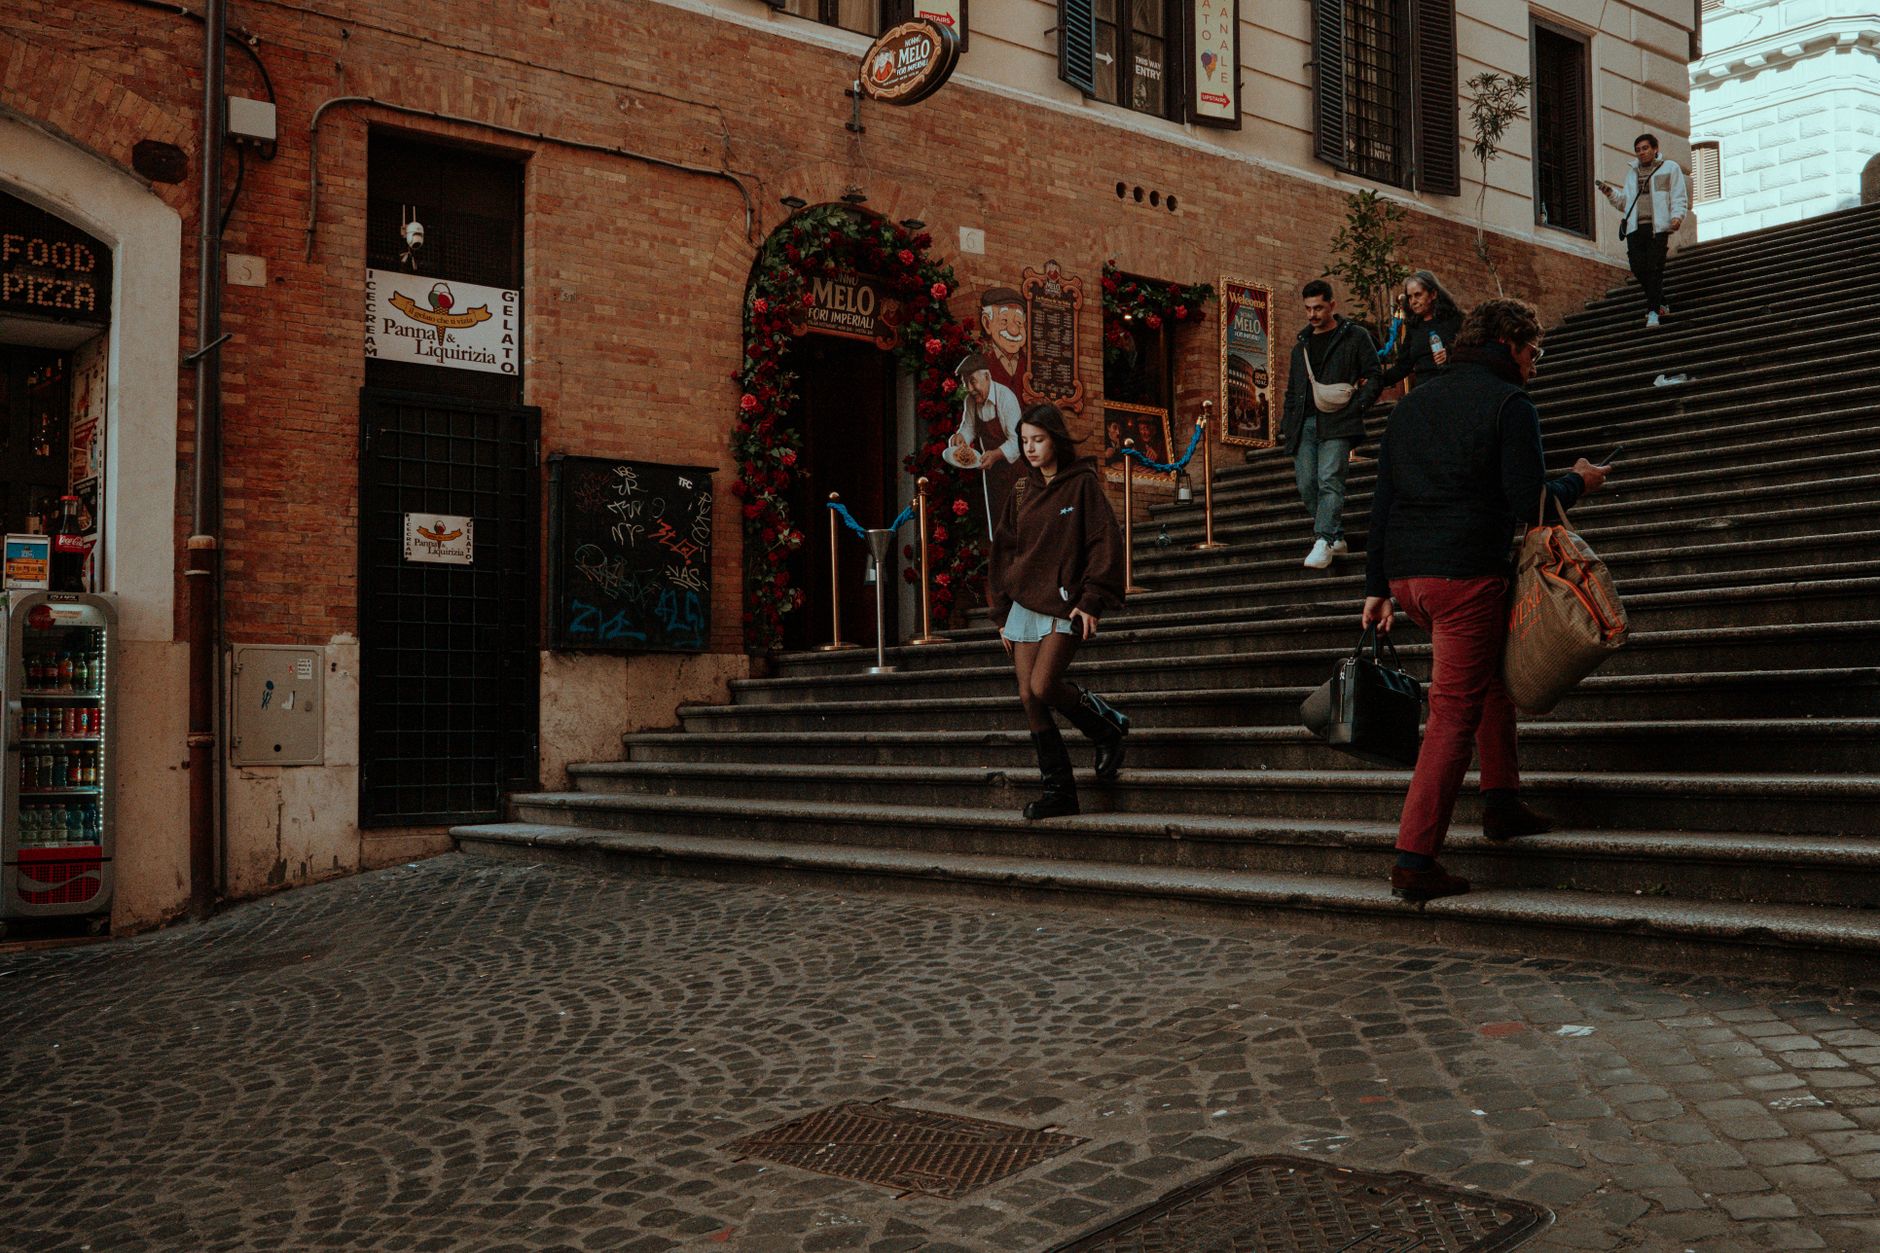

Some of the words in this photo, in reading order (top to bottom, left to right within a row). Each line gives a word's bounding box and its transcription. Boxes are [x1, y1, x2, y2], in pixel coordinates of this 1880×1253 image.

[920, 13, 951, 24] UPSTAIRS
[1219, 0, 1229, 84] ANALE
[897, 39, 931, 69] MELO
[1135, 56, 1148, 66] THIS
[1149, 59, 1162, 69] WAY
[1135, 65, 1162, 80] ENTRY
[1202, 95, 1227, 104] UPSTAIRS
[2, 233, 96, 272] FOOD
[2, 272, 96, 312] PIZZA
[812, 276, 875, 316] MELO
[1228, 291, 1266, 309] Welcome
[414, 311, 437, 323] gelato
[437, 316, 447, 324] che
[456, 317, 474, 325] vizia
[808, 307, 828, 322] FORI
[830, 311, 874, 330] IMPERIALI
[1233, 315, 1262, 335] MELO
[383, 318, 437, 341] Panna
[446, 334, 456, 344] &
[501, 291, 515, 374] GELATO
[414, 339, 497, 364] Liquirizia
[414, 539, 437, 548] Panna
[428, 546, 464, 558] Liquirizia
